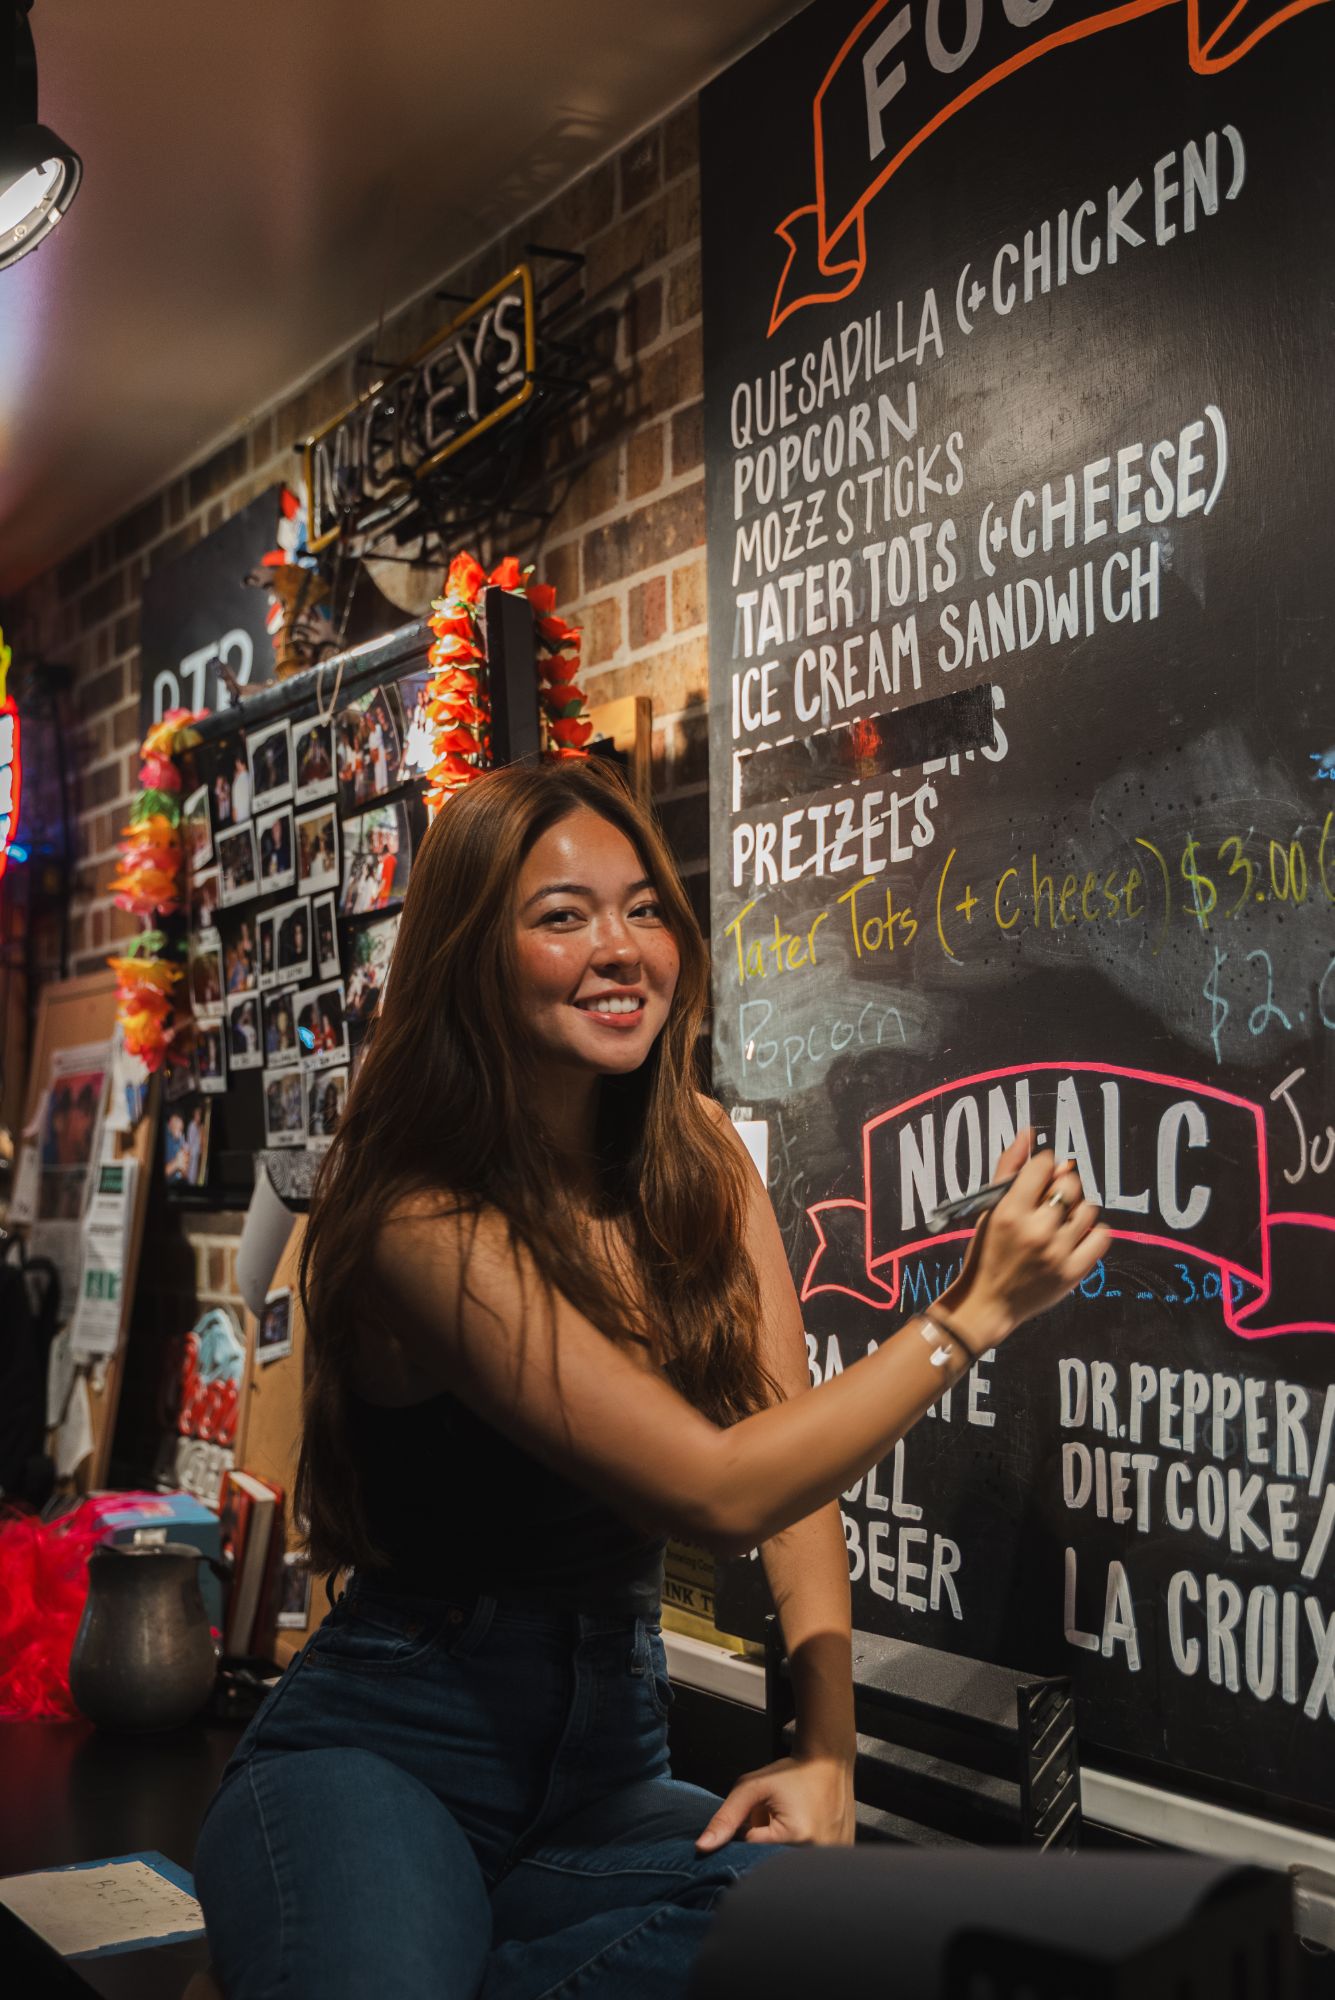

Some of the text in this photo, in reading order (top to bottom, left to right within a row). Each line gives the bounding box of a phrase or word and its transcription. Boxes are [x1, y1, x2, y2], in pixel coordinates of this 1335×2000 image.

[862, 0, 1053, 161] FO
[731, 125, 1245, 449] QUESADILLA (+CHICKEN)
[732, 431, 964, 587] MOZZ STICKS
[734, 381, 918, 521] POPCORN
[736, 404, 1227, 658] TATER TOTS (+CHEESE)
[732, 541, 1160, 739] ICE CREAM SANDWICH
[724, 896, 829, 986] Tater
[837, 875, 918, 958] Tots
[1181, 831, 1307, 929] $3.00
[733, 780, 938, 887] PRETZELS
[739, 999, 906, 1088] Popcorn
[1062, 1441, 1160, 1533] DIET
[840, 1510, 963, 1620] BEER
[1064, 1546, 1335, 1721] LA CROIX
